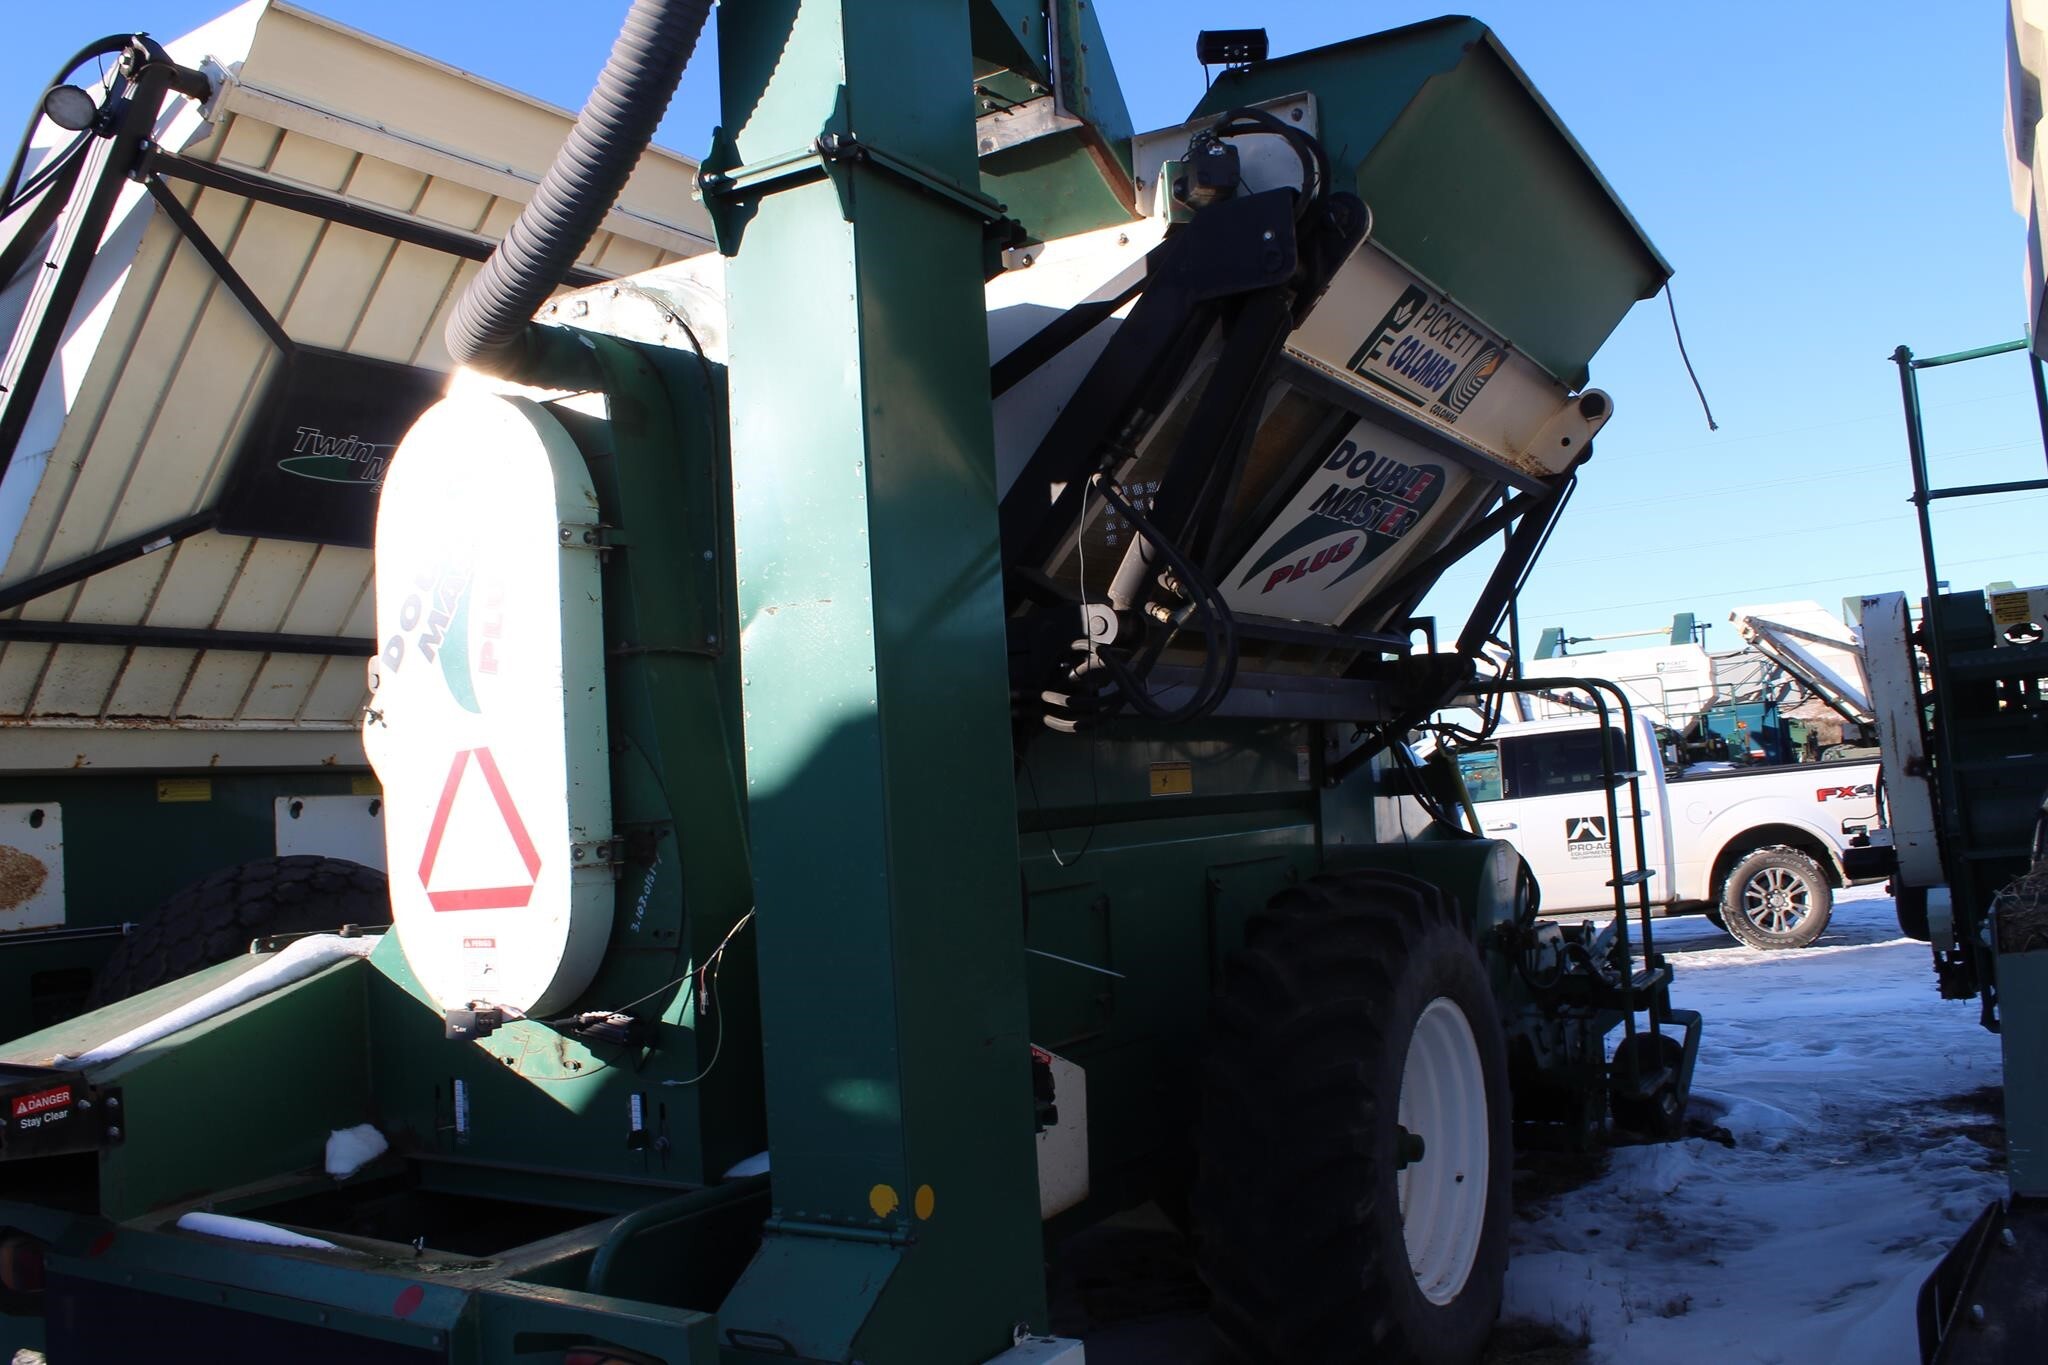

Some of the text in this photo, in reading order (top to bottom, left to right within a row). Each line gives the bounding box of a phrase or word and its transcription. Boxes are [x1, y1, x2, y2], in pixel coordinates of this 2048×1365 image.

[1414, 304, 1482, 358] PICKETT
[1387, 335, 1457, 392] COLOMBO
[1430, 404, 1458, 424] COLOMBO
[293, 426, 375, 462] Twin
[1323, 440, 1436, 503] DOUBLE
[1308, 483, 1420, 539] MASTER
[1260, 536, 1360, 594] PLUS
[1817, 784, 1875, 802] FX4
[20, 1109, 68, 1129] Stay Clear
[28, 1091, 70, 1110] DANGER
